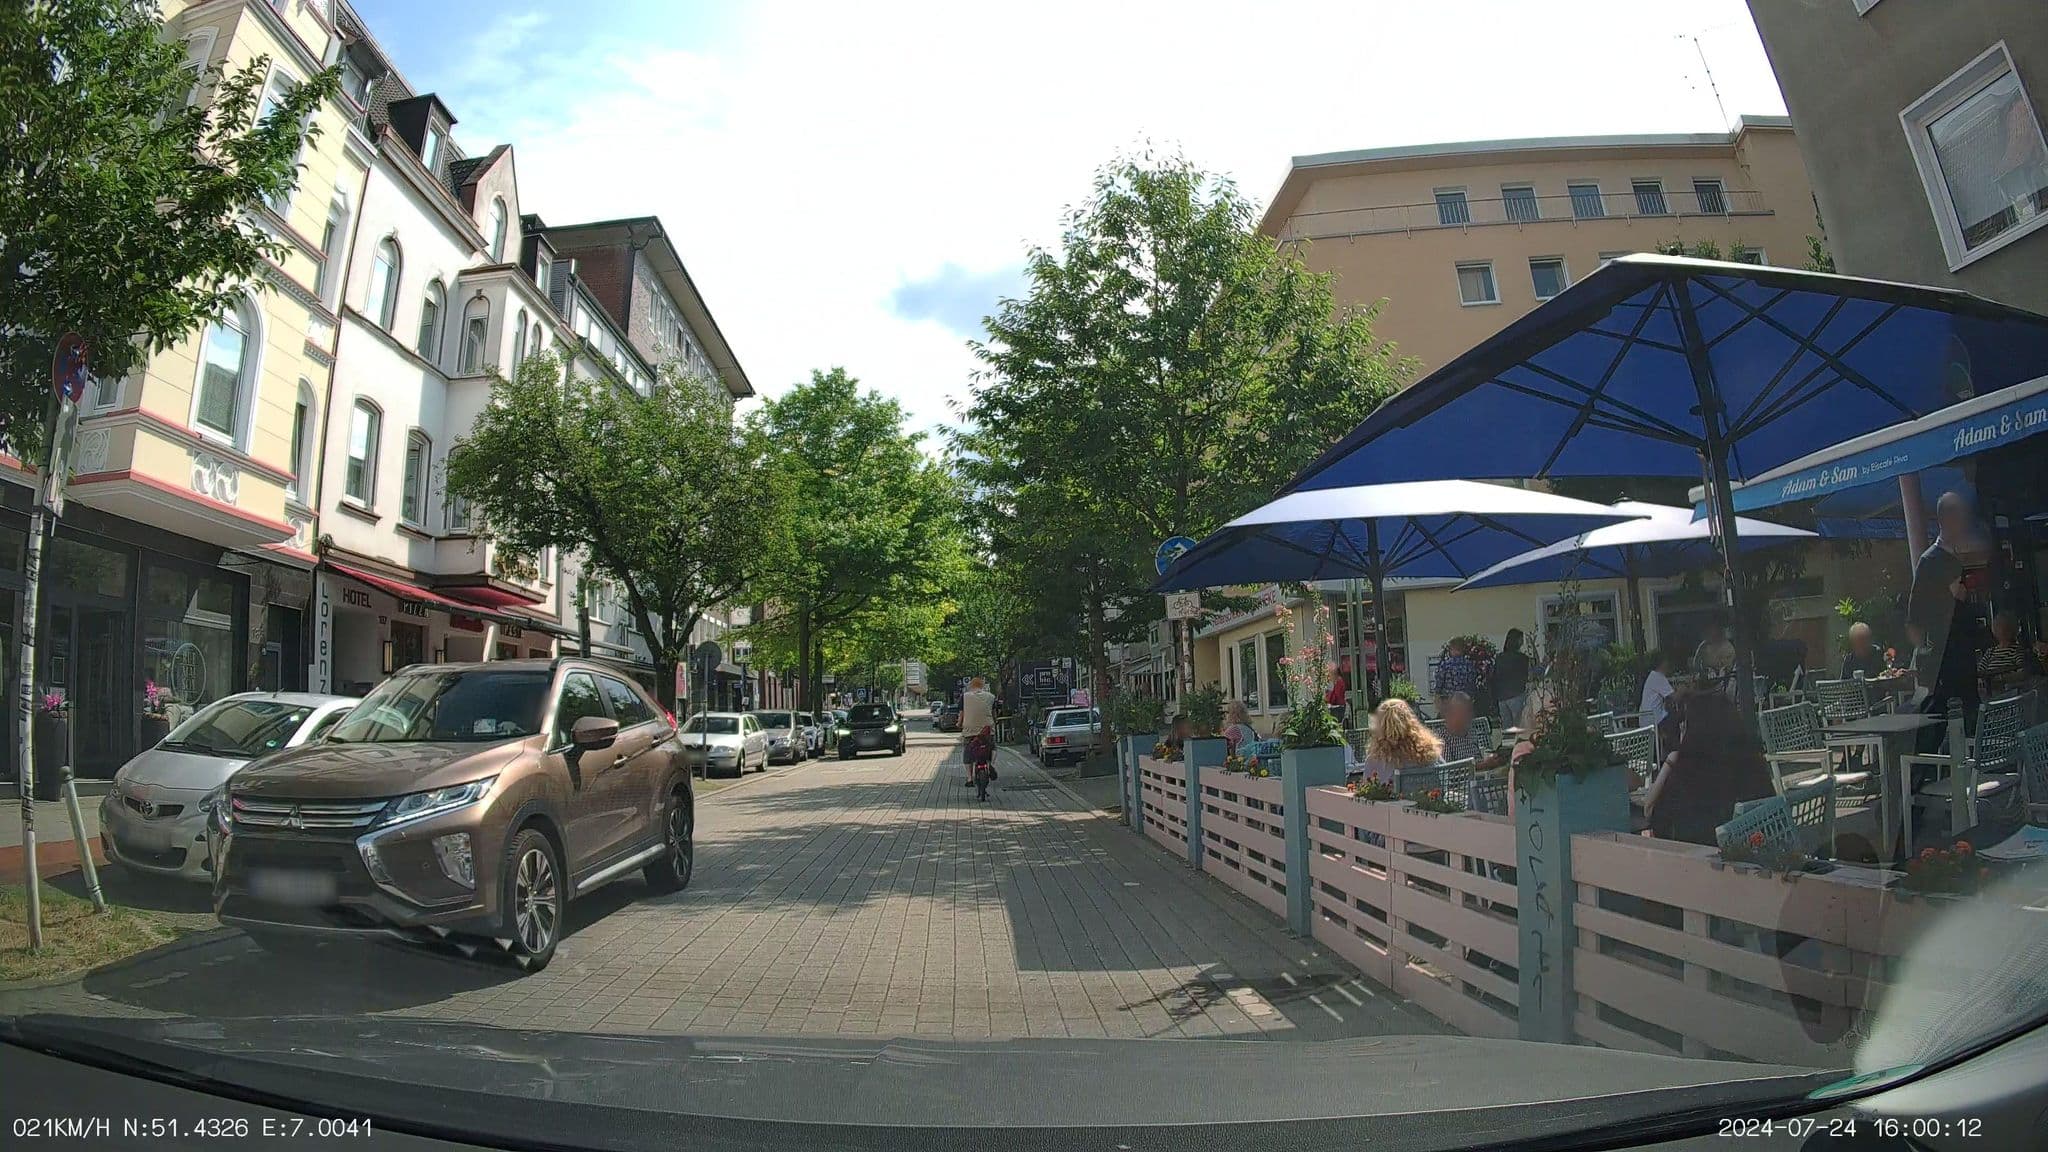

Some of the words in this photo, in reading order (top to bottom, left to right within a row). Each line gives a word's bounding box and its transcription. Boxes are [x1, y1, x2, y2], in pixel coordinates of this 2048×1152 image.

[1954, 425, 1997, 451] Adam
[2001, 415, 2011, 435] &
[2015, 408, 2048, 430] Sam
[1782, 478, 1816, 498] Adam
[1820, 470, 1828, 487] &
[1831, 466, 1857, 484] Sam
[343, 587, 371, 608] HOTEL
[319, 582, 329, 694] Lorenz
